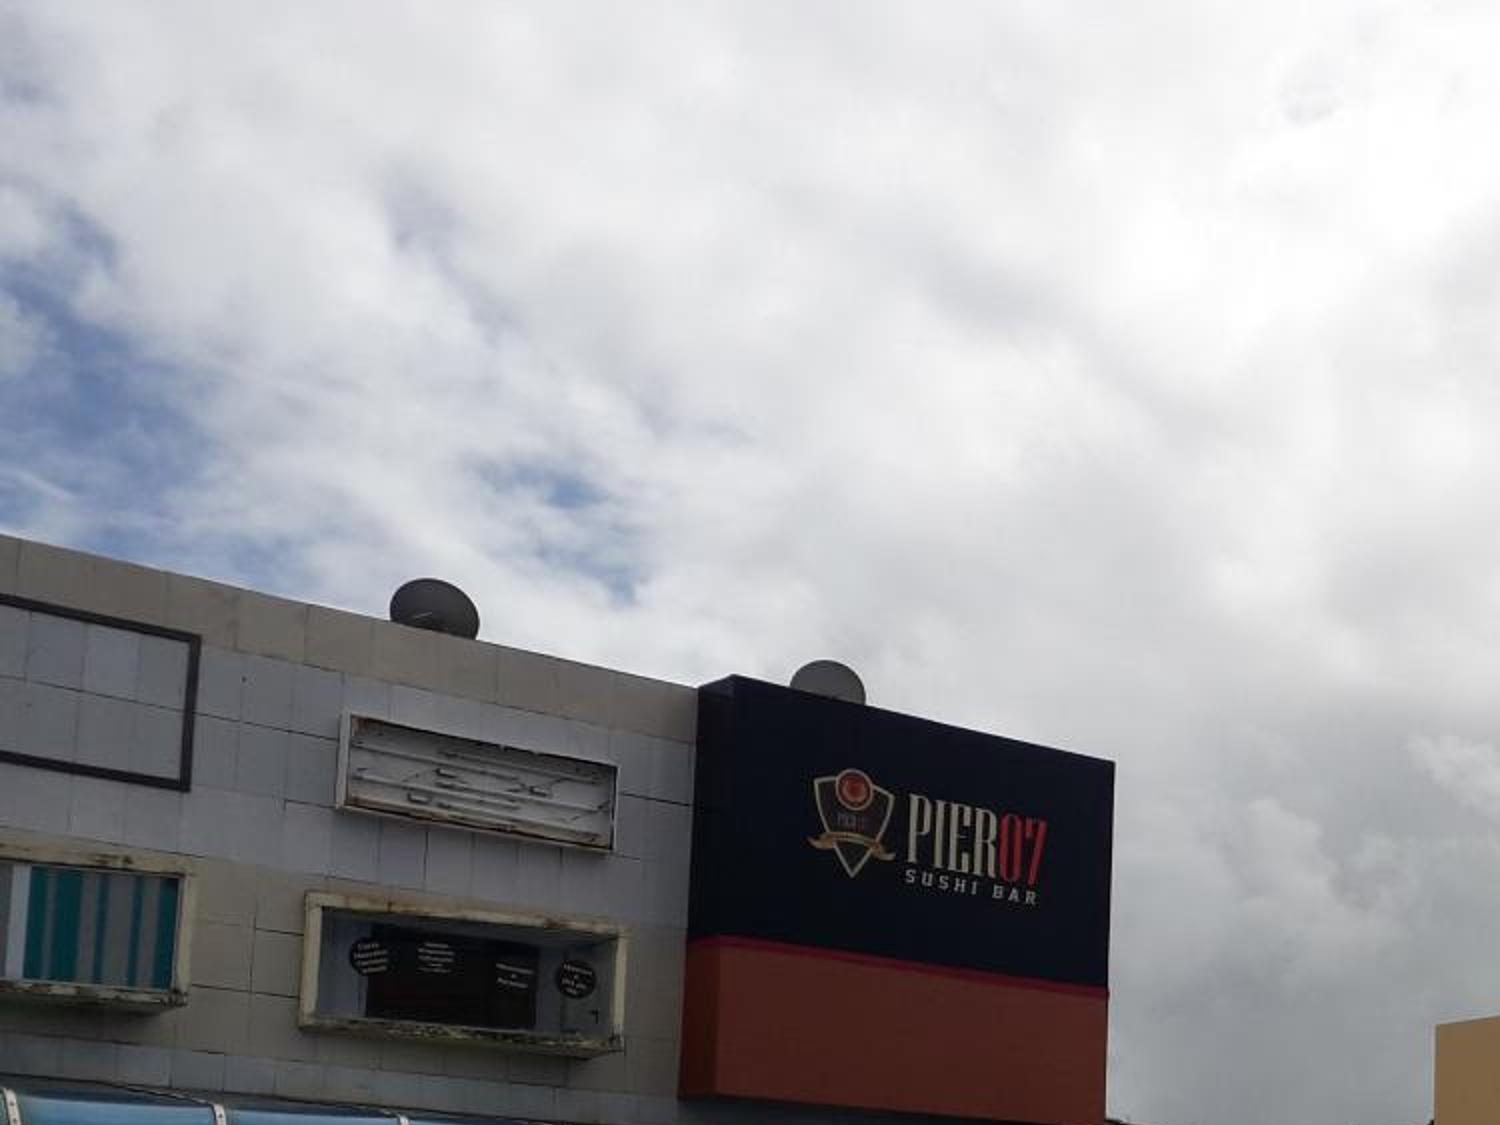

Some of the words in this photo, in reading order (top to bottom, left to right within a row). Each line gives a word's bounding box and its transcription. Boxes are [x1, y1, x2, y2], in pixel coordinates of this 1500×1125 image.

[907, 793, 1049, 886] PIER07
[904, 868, 979, 896] SUSHI
[992, 884, 1037, 906] BAR
